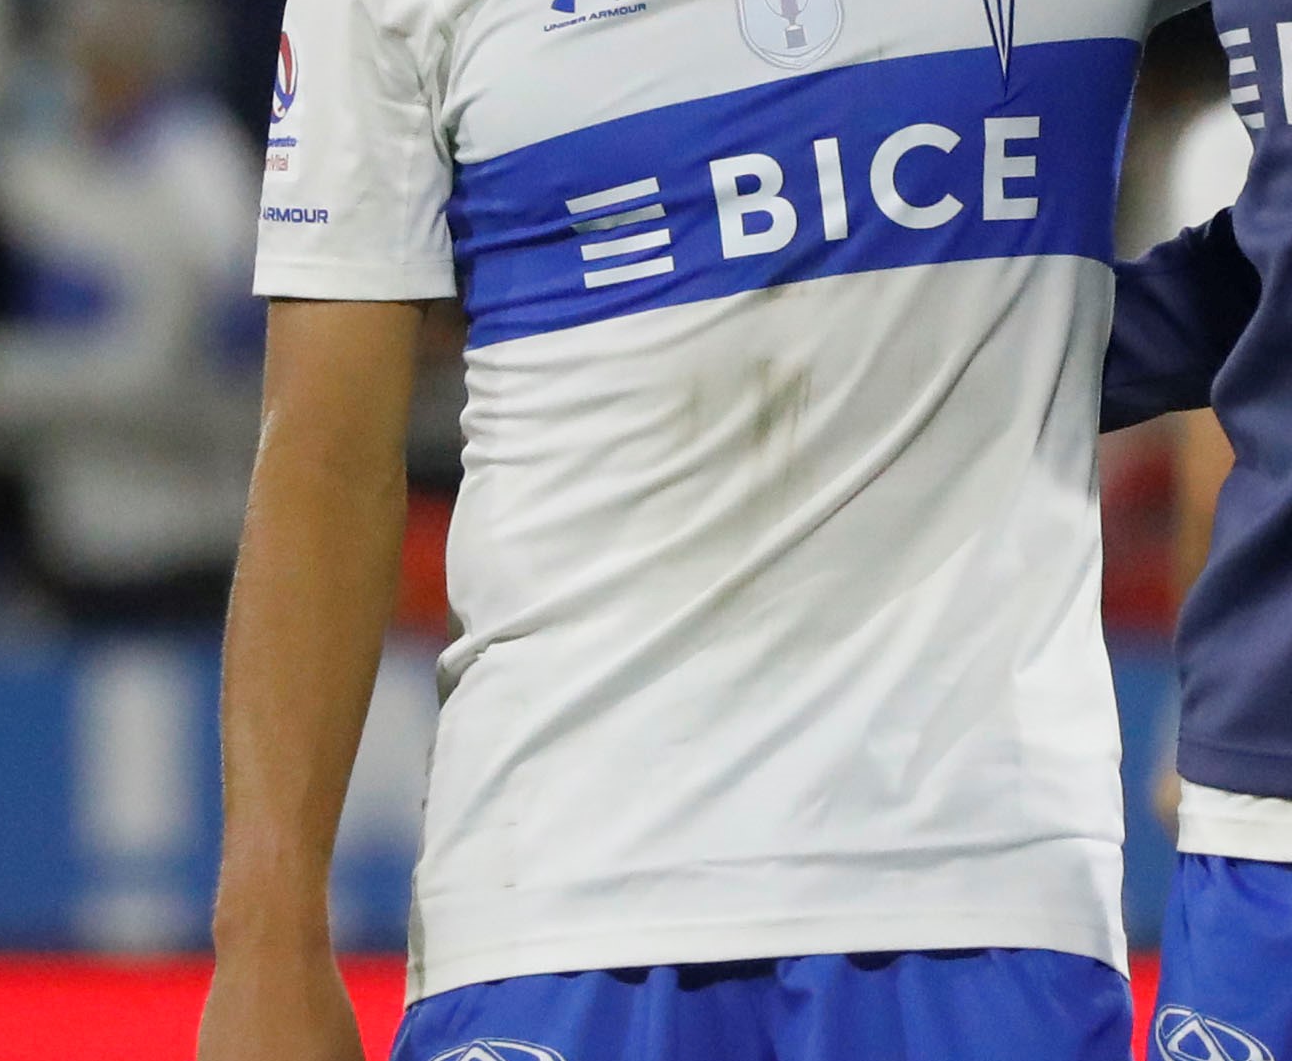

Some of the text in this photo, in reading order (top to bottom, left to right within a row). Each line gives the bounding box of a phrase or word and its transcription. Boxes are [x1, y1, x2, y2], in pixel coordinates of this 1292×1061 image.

[543, 3, 647, 32] UNDER ARMOUR
[709, 116, 1040, 260] BICE
